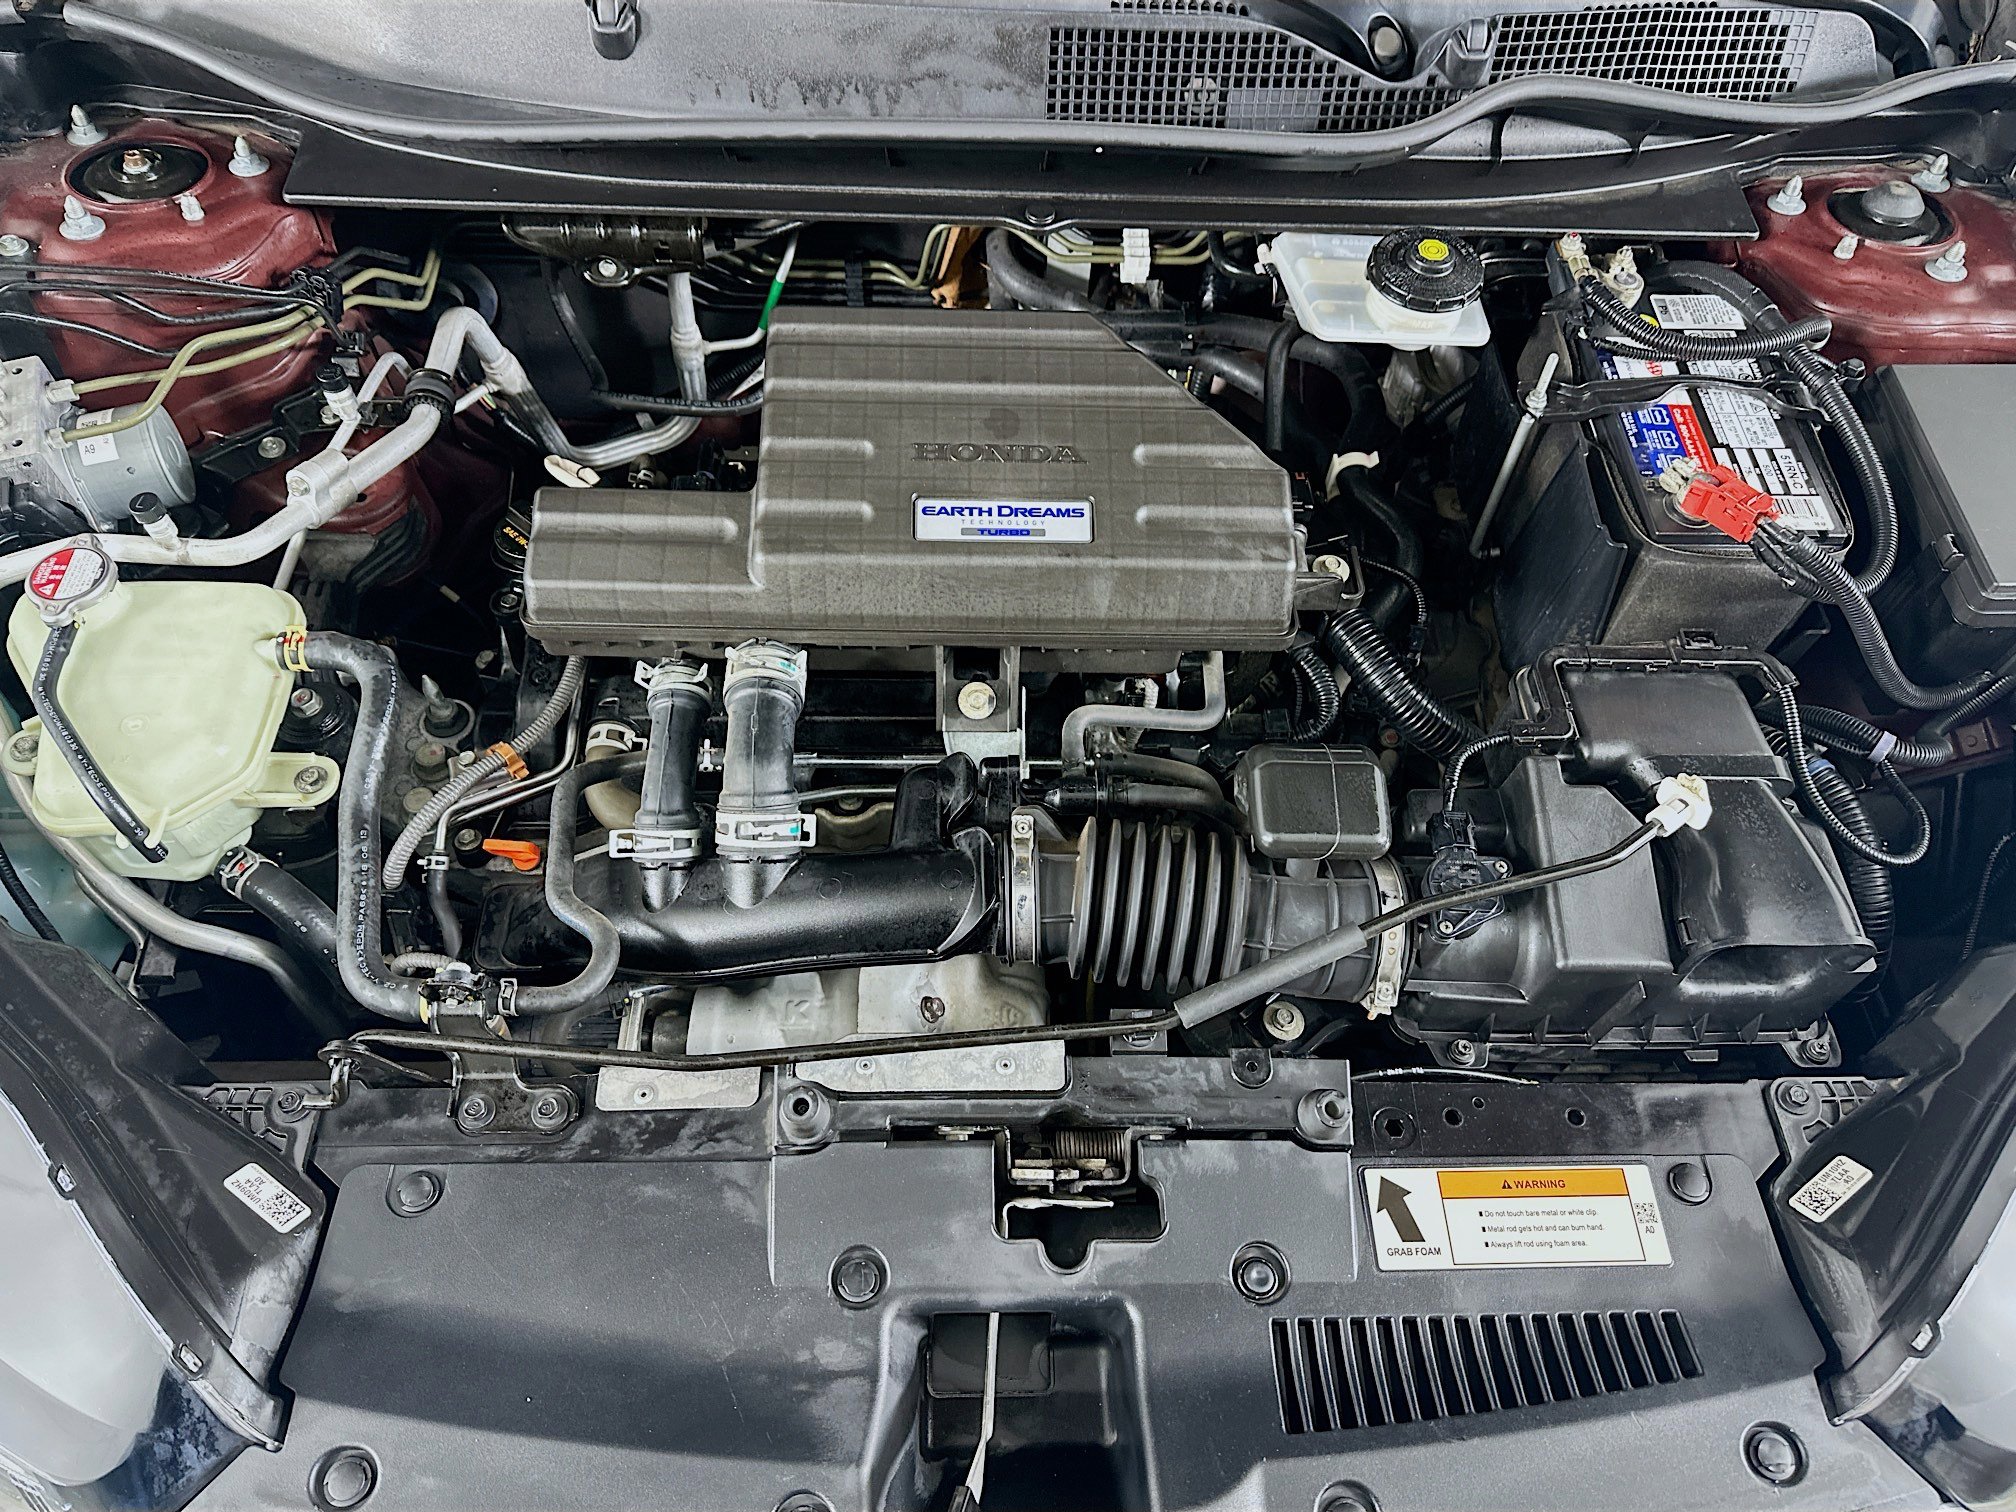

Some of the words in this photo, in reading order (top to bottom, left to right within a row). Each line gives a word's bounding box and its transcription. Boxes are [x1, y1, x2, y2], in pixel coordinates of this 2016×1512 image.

[84, 444, 95, 455] A9
[912, 442, 1089, 464] HONDA
[1762, 464, 1773, 476] 500
[1779, 455, 1804, 488] 51RN-C
[921, 506, 993, 517] EARTH
[997, 505, 1085, 518] DREAMS
[977, 528, 1031, 536] TURBO
[1819, 1159, 1846, 1183] UM10HZ
[1831, 1168, 1850, 1183] TLAA
[245, 1178, 263, 1195] TLAA
[1514, 1180, 1566, 1189] WARNING
[231, 1179, 261, 1204] UM09HZ
[1491, 1240, 1513, 1249] Always
[1536, 1240, 1552, 1248] using
[1387, 1248, 1413, 1256] GRAB
[1416, 1247, 1441, 1256] FOAM
